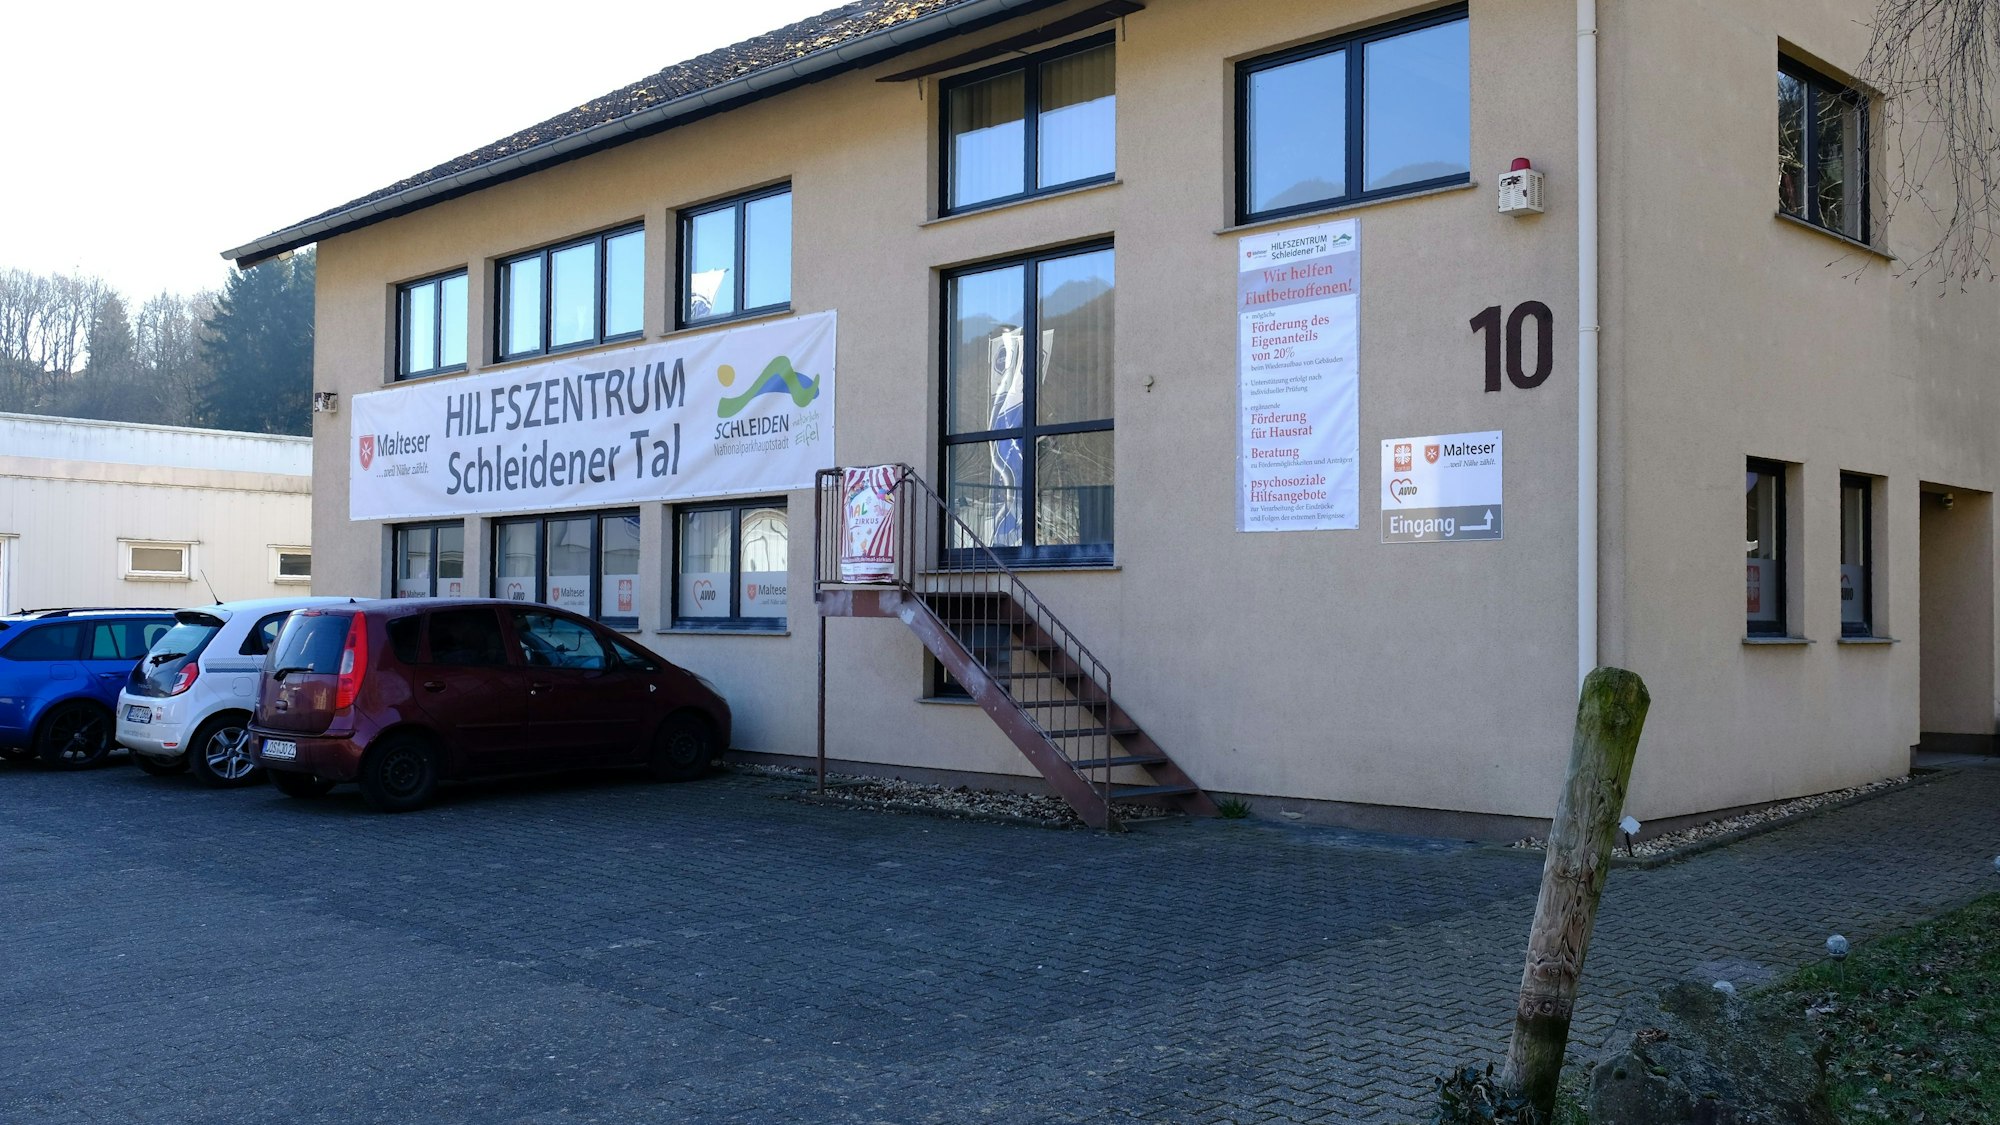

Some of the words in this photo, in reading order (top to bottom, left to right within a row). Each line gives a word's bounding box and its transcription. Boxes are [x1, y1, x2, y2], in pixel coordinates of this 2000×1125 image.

[1271, 234, 1328, 250] HILFSZENTRUM
[1272, 247, 1314, 260] Schleidener
[1316, 244, 1326, 252] Tal
[1264, 270, 1286, 283] Wir
[1291, 263, 1333, 280] helfen
[1245, 278, 1352, 306] Flutbetroffenen!
[1252, 310, 1275, 320] mögliche
[1252, 318, 1308, 333] Förderung
[1311, 315, 1330, 326] des
[1252, 330, 1318, 350] Eigenanteils
[1469, 300, 1553, 393] 10
[1252, 350, 1270, 362] von
[1274, 346, 1295, 359] 20%
[1265, 361, 1302, 370] Wiederaufbau
[1315, 357, 1343, 365] Gebäuden
[1250, 378, 1288, 386] Unterstützung
[1289, 375, 1308, 383] erfolgt
[445, 357, 686, 438] HILFSZENTRUM
[1250, 386, 1284, 395] individueller
[1286, 385, 1308, 393] Prüfung
[1250, 402, 1280, 411] ergänzende
[1251, 412, 1307, 424] Förderung
[714, 414, 789, 440] SCHLEIDEN
[1251, 428, 1266, 439] für
[1269, 425, 1312, 437] Hausrat
[378, 431, 430, 456] Malteser
[714, 436, 789, 456] Nationalparkhauptstadt
[1444, 443, 1495, 456] Malteser
[446, 443, 619, 495] Schleidener
[635, 423, 681, 479] Tal
[1251, 446, 1300, 459] Beratung
[1251, 474, 1326, 491] psychosoziale
[1251, 489, 1327, 504] Hilfsangebote
[1398, 486, 1417, 496] AWO
[1260, 504, 1294, 512] Verarbeitung
[1390, 516, 1455, 538] Eingang
[513, 591, 525, 600] AWO
[561, 587, 584, 597] Malteser
[700, 590, 716, 600] AWO
